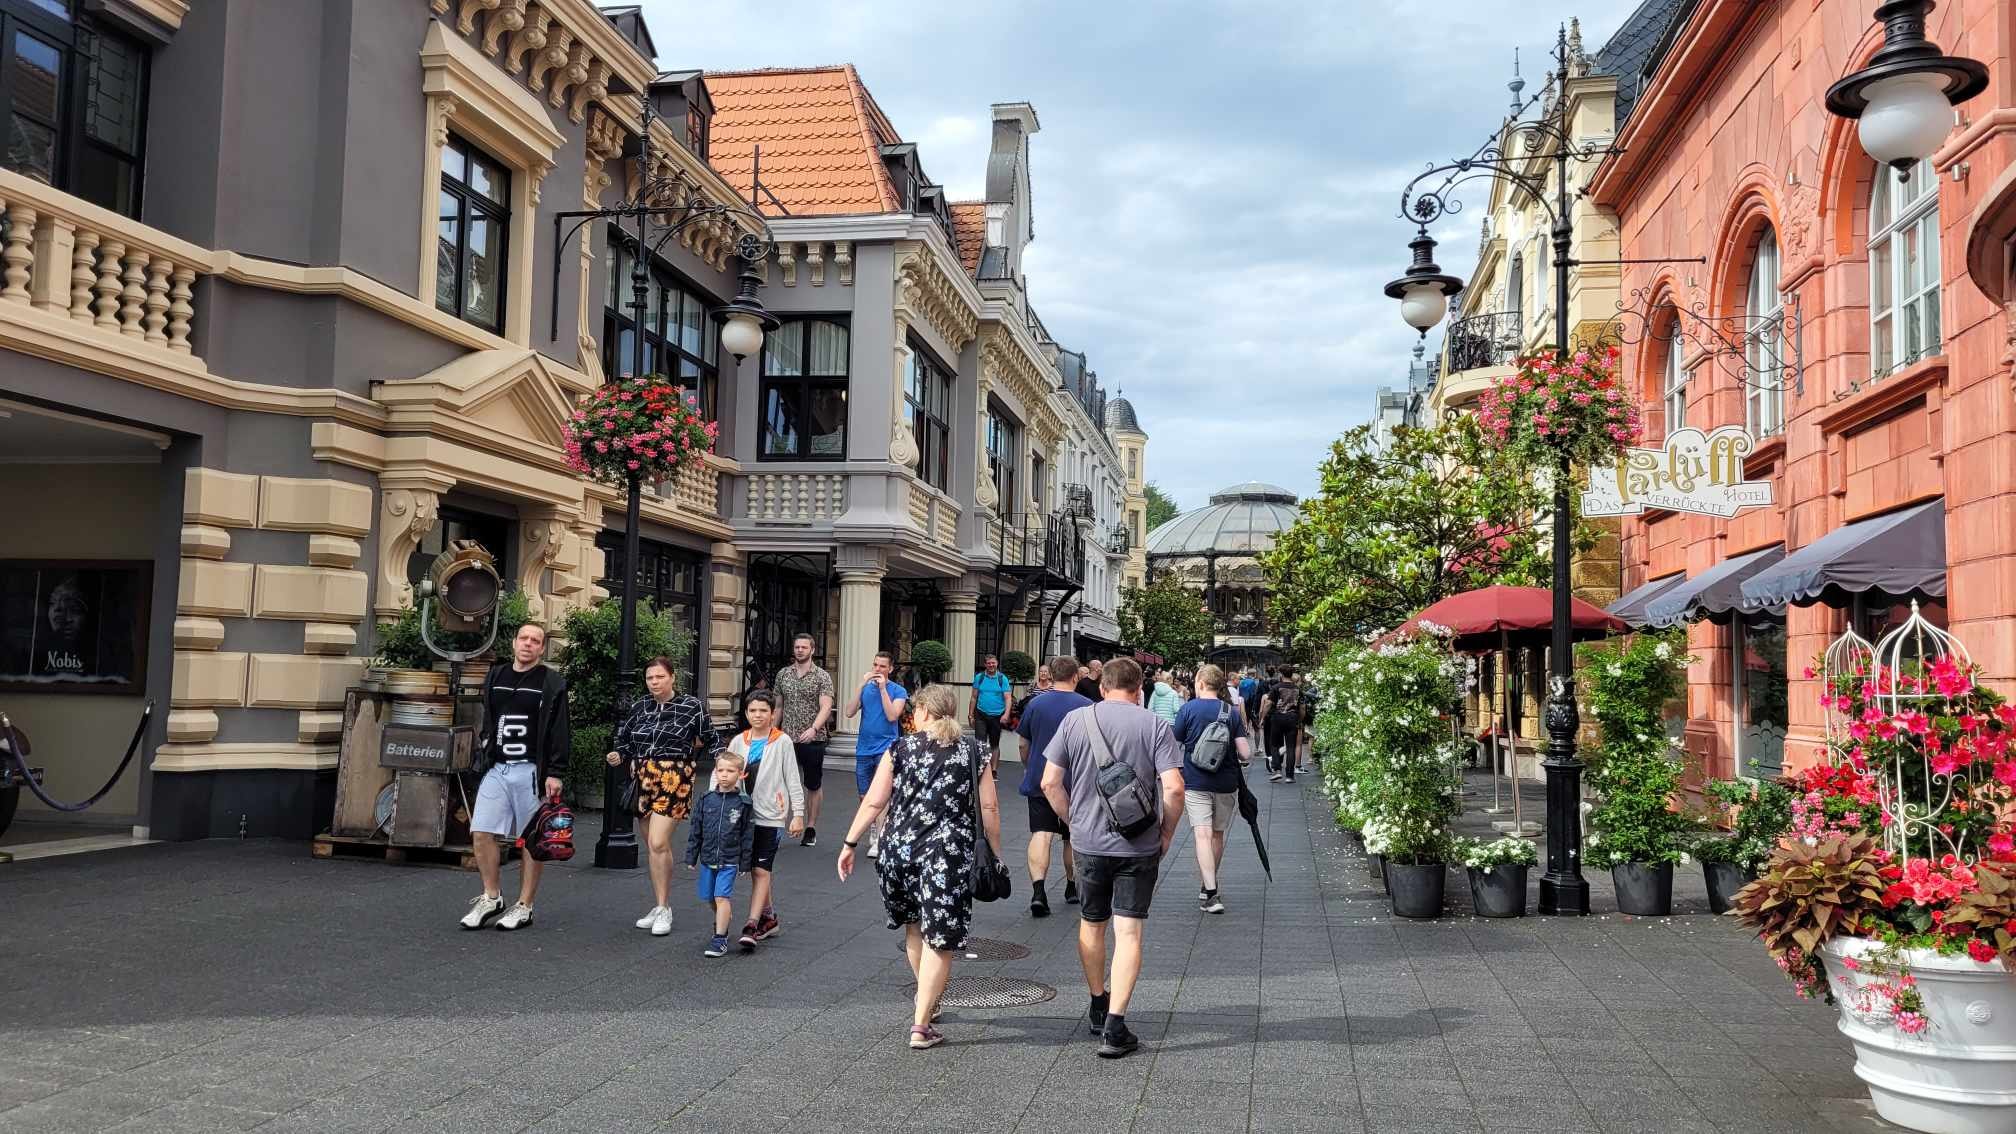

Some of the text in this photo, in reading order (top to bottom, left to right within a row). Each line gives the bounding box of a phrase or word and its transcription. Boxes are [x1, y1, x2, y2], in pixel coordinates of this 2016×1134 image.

[1615, 435, 1748, 505] Tartüff
[1646, 493, 1726, 514] VERRÜCKTE
[45, 650, 83, 671] Nobis
[503, 715, 528, 763] ICO
[386, 743, 444, 759] Batterien
